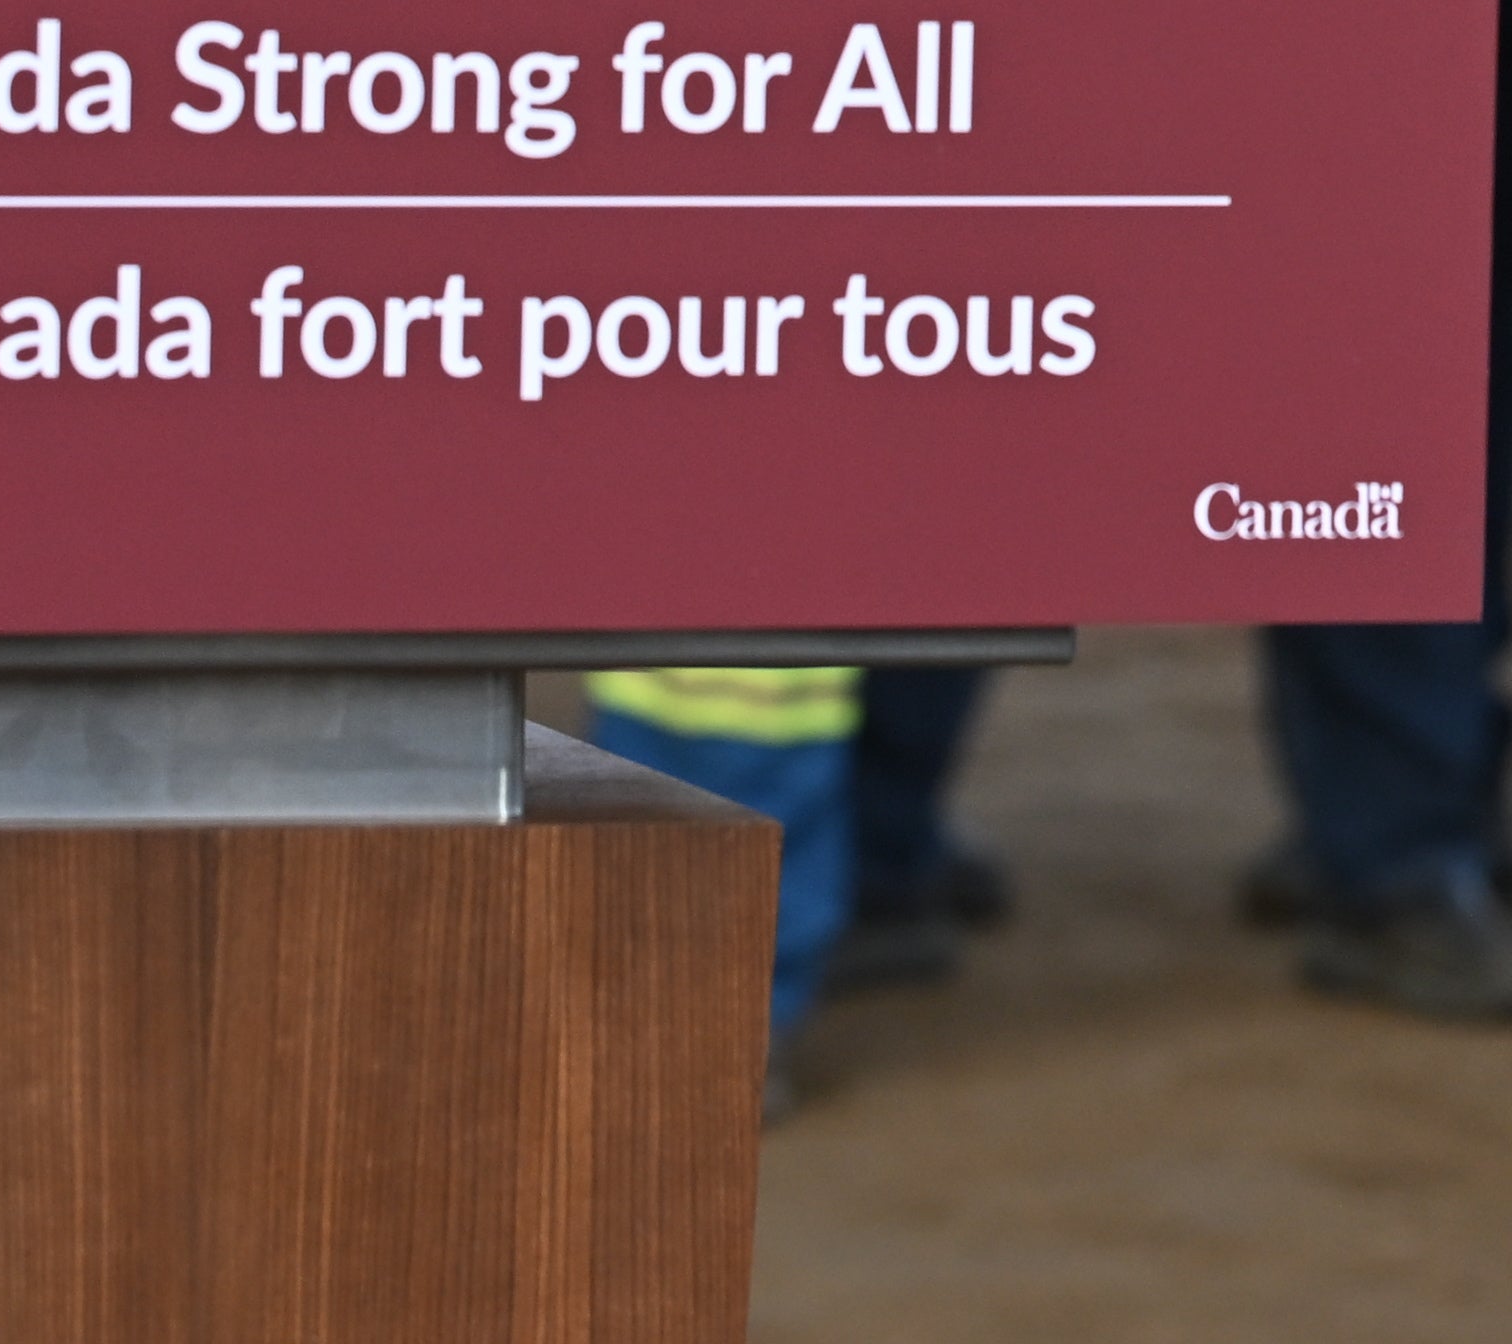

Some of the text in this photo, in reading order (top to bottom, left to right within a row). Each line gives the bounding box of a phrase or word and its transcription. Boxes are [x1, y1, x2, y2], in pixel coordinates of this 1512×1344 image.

[171, 20, 580, 159] Strong
[612, 21, 793, 134] for
[812, 20, 975, 134] All
[250, 265, 484, 379] fort
[519, 294, 805, 402] pour
[832, 273, 1096, 377] tous
[1193, 481, 1404, 541] Canada
